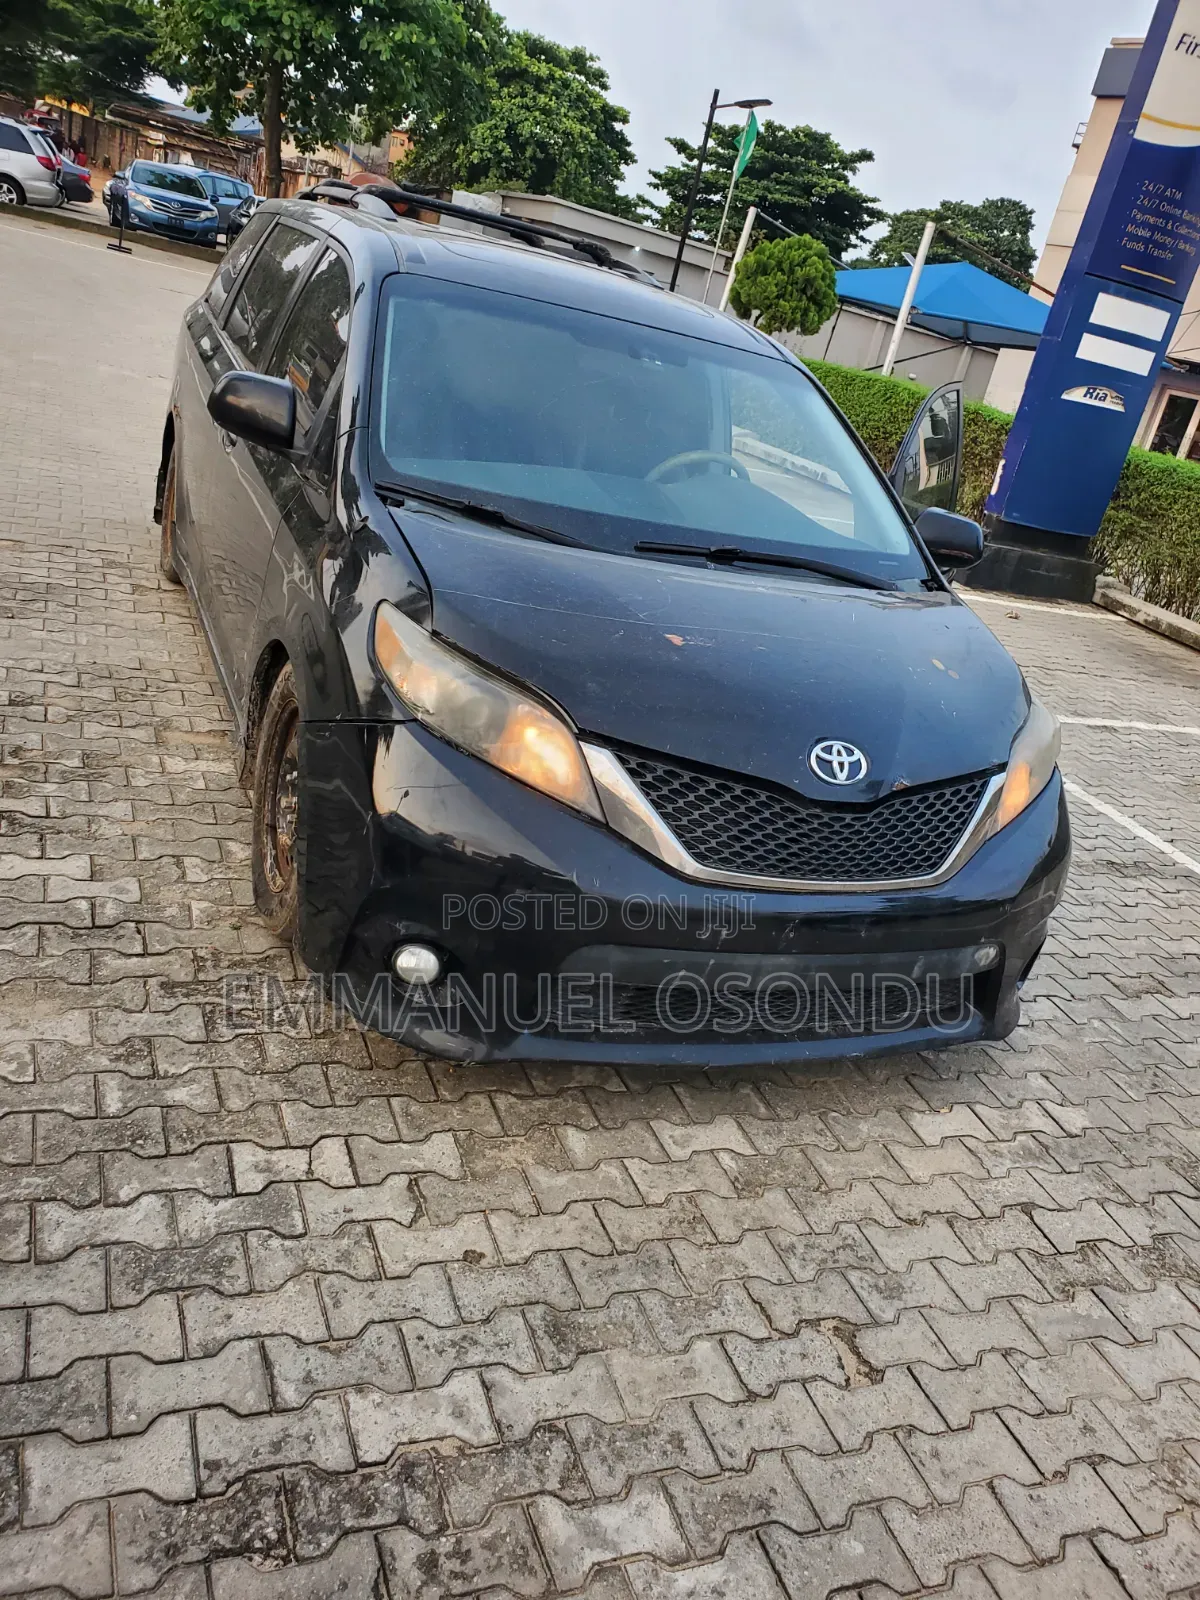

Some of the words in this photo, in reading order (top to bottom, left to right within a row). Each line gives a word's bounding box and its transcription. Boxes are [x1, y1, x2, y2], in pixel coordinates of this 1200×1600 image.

[1142, 180, 1164, 194] 24/7
[1164, 188, 1182, 200] ATM
[1137, 195, 1159, 208] 24/7
[1160, 202, 1182, 216] Online
[1126, 224, 1152, 238] Mobile
[1131, 209, 1166, 227] Payments
[1167, 220, 1172, 230] &
[1174, 223, 1200, 240] Collections
[1121, 238, 1145, 252] Funds
[1147, 245, 1174, 260] Transfer
[1083, 387, 1108, 402] Ria
